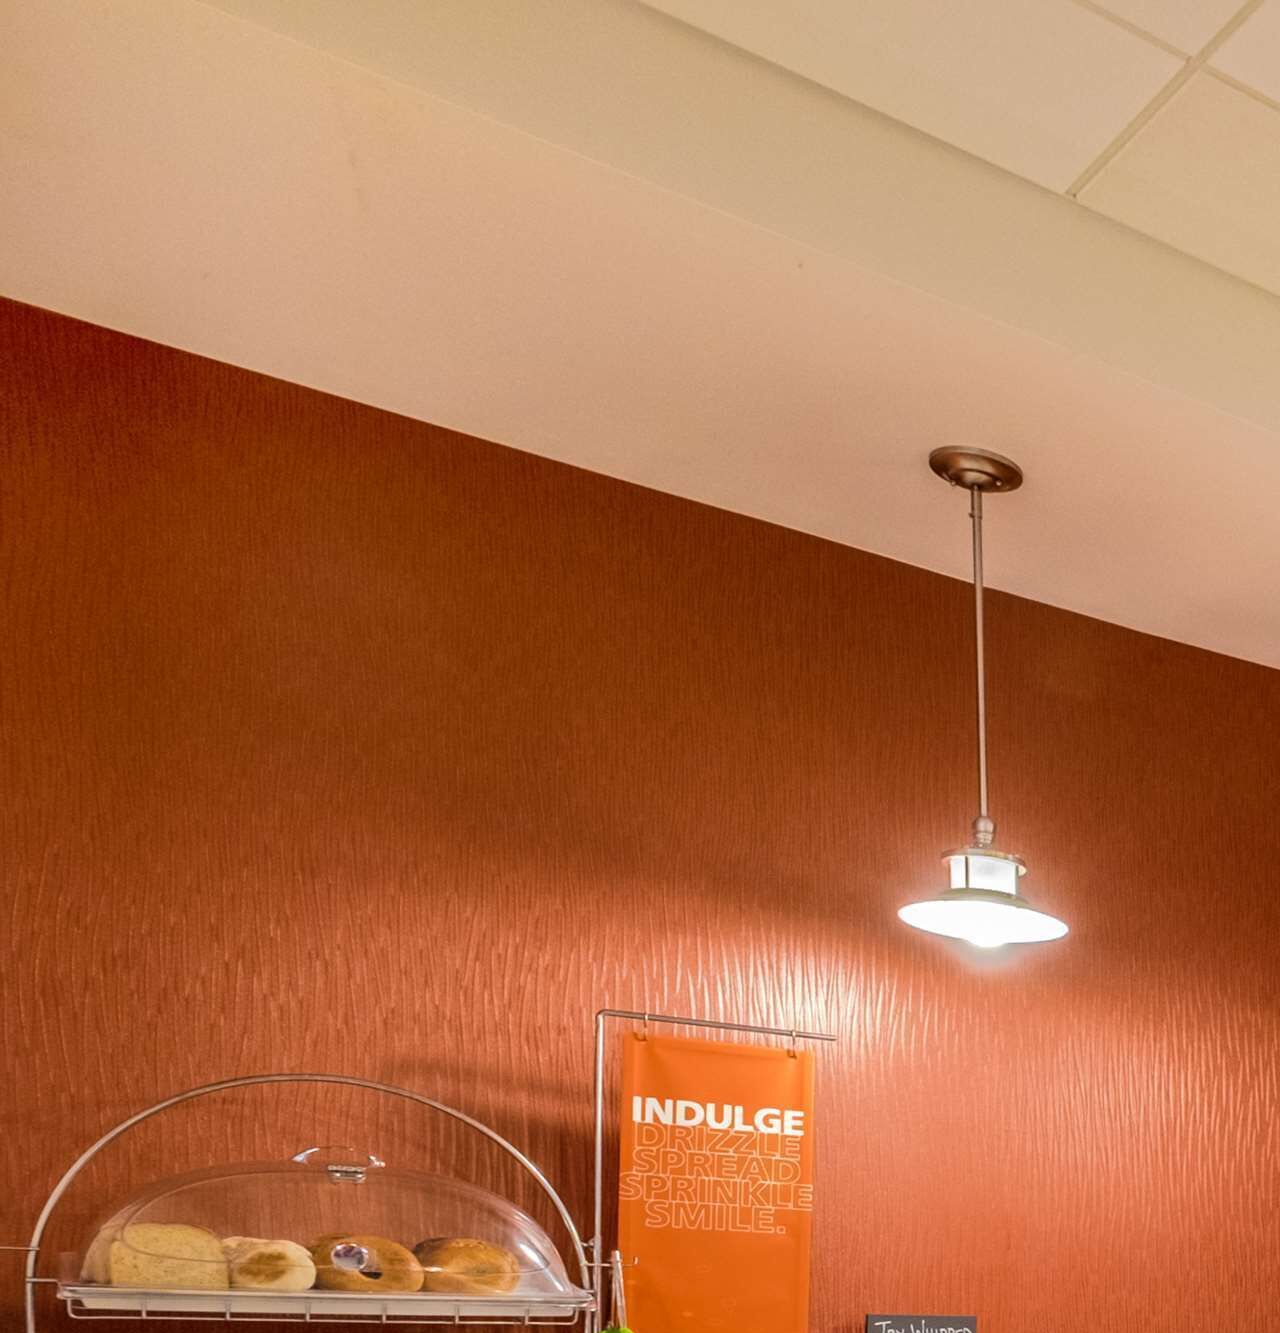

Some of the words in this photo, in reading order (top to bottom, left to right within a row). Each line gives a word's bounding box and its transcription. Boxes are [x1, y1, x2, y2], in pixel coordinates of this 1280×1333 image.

[632, 1095, 805, 1136] INDULGE
[634, 1121, 801, 1161] DRIZZLE
[632, 1146, 801, 1184] SPREAD
[619, 1171, 814, 1211] SPRINKLE
[645, 1199, 786, 1234] SMILE.
